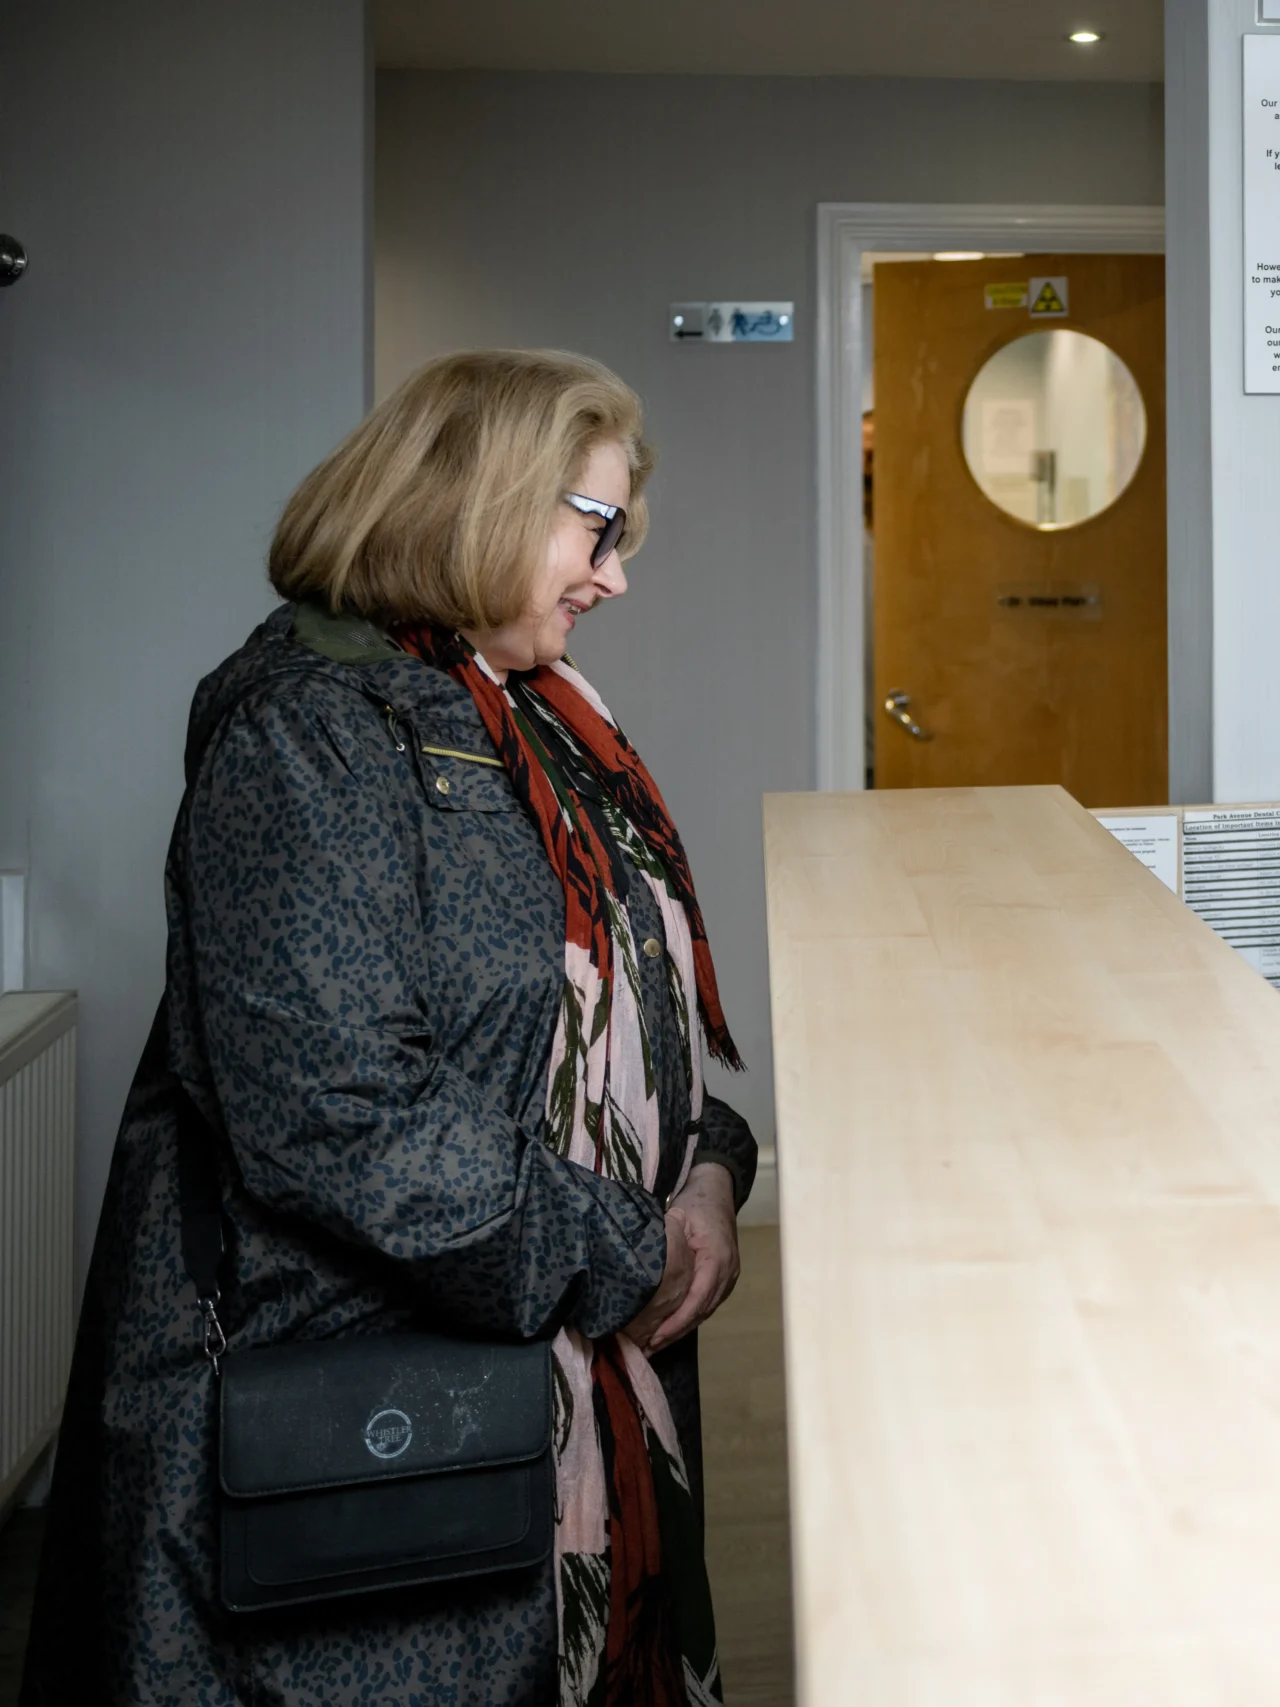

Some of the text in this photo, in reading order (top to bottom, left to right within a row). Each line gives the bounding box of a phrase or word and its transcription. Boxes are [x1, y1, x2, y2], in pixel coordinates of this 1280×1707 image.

[1260, 98, 1277, 107] Our
[366, 1426, 412, 1438] WHISTLER
[378, 1435, 401, 1443] TREE
